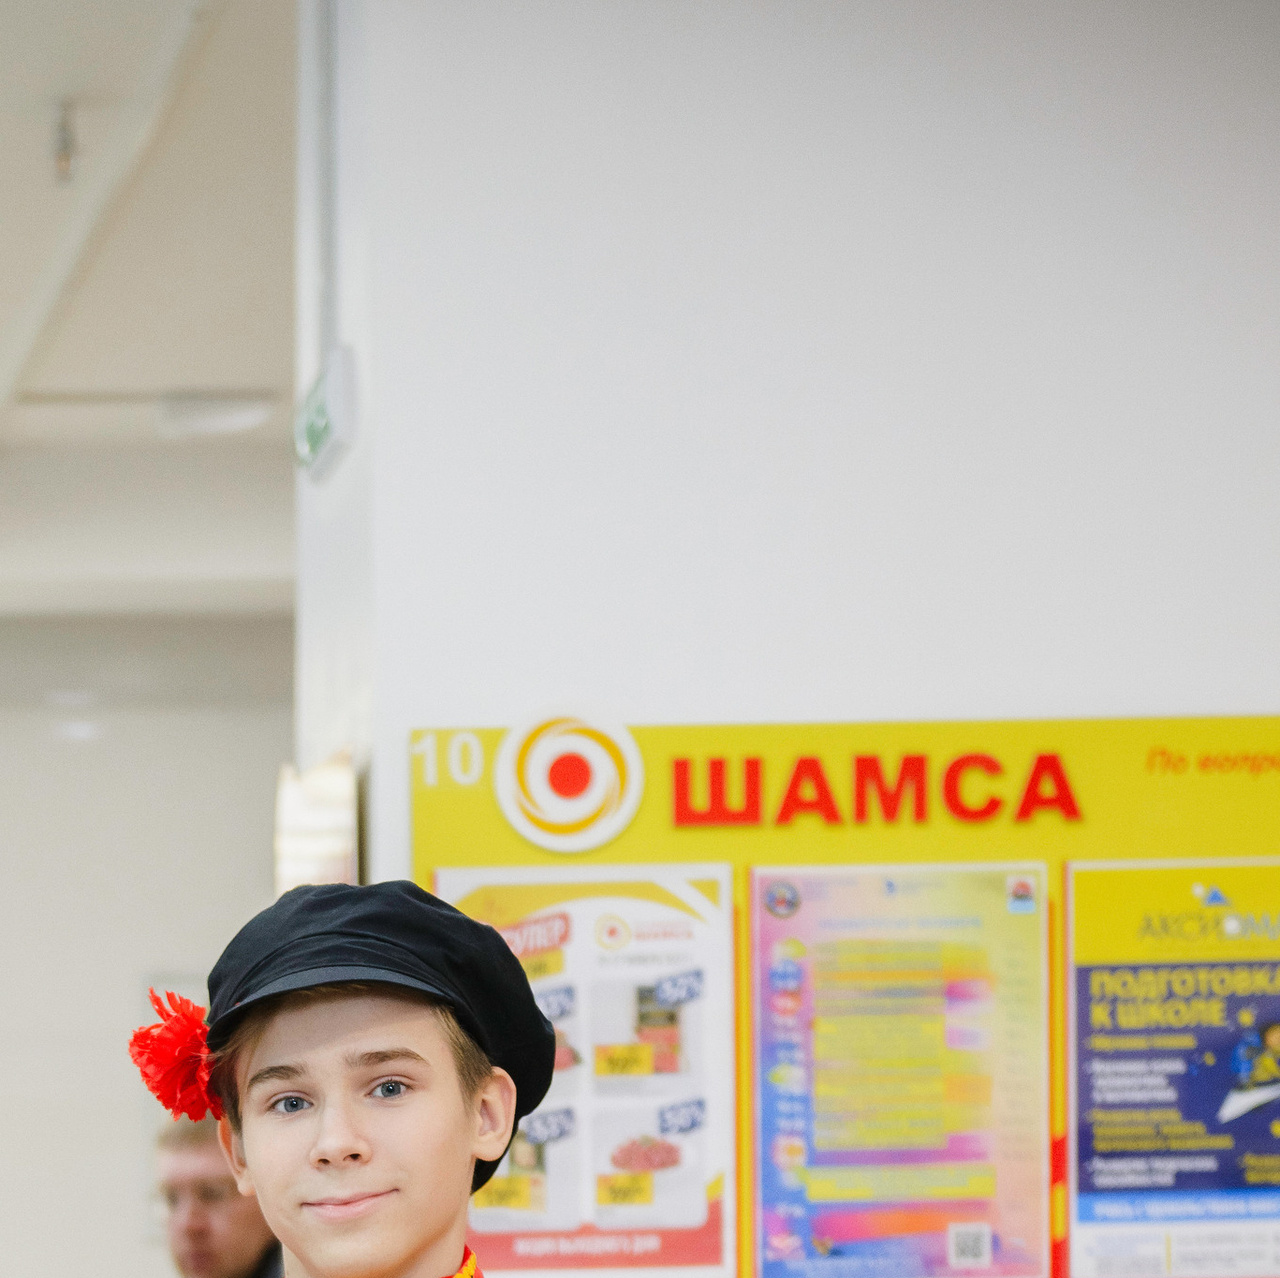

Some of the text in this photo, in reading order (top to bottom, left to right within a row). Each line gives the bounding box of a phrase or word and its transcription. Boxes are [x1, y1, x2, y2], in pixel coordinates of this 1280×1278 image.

[411, 731, 484, 786] 10
[672, 753, 1084, 829] ШАМСА
[1091, 1000, 1228, 1029] К ШКОЛЕ
